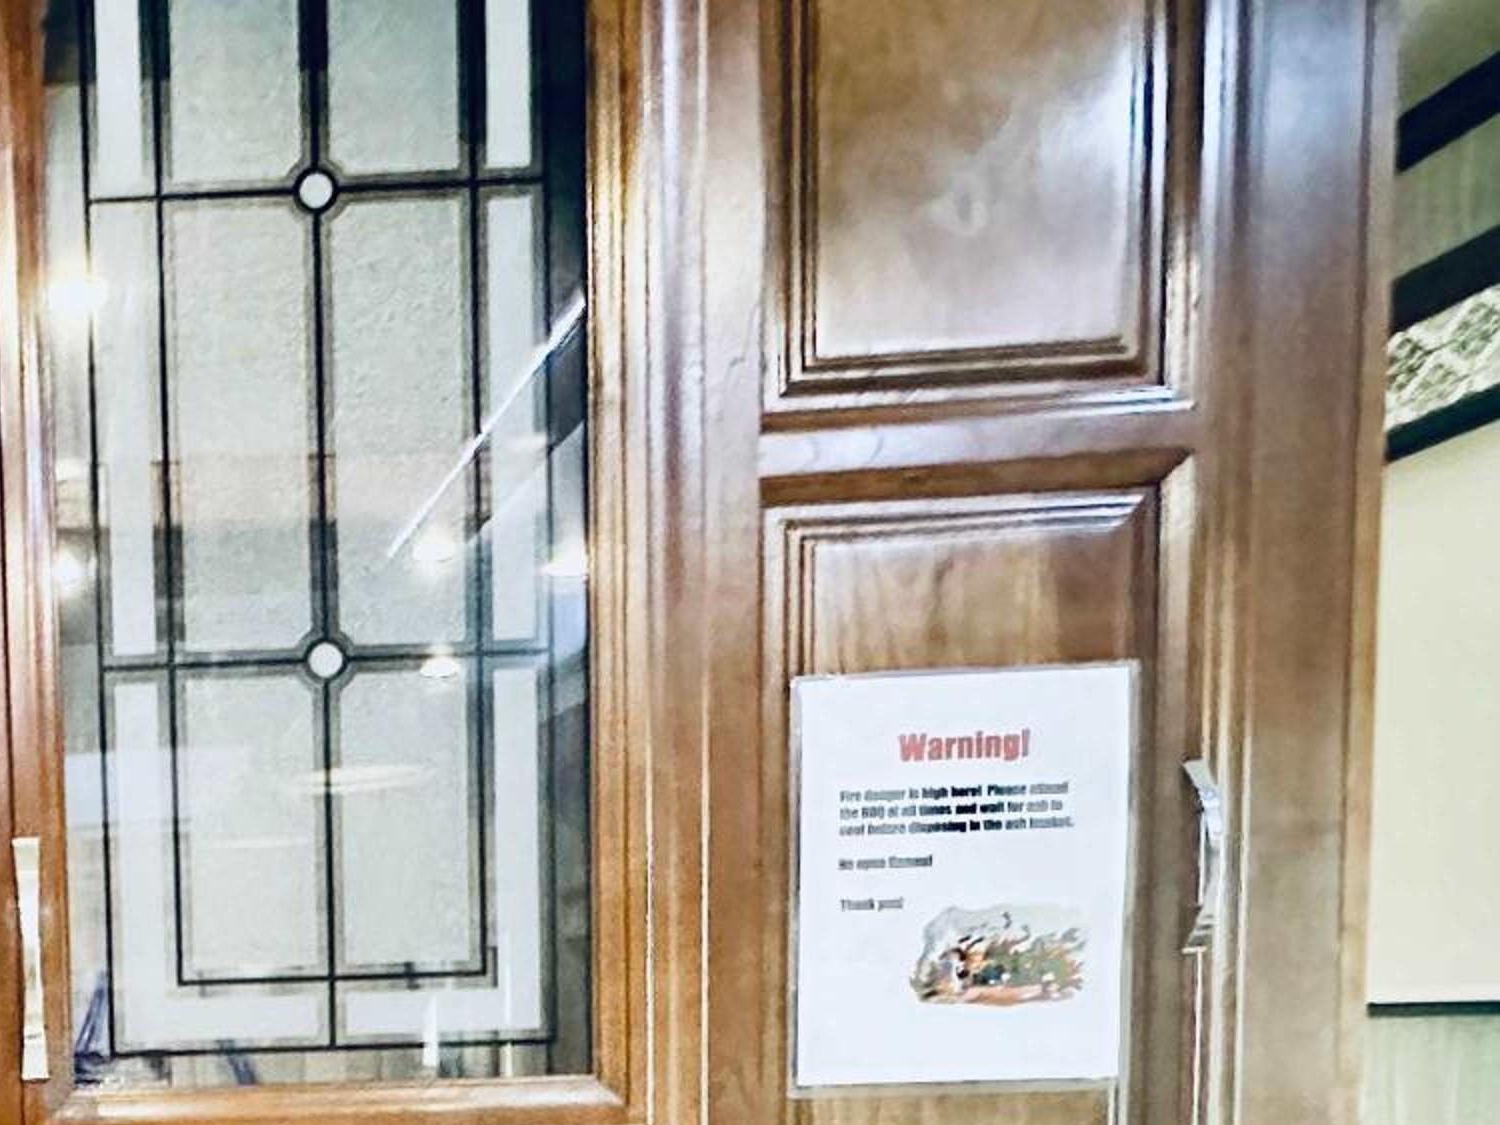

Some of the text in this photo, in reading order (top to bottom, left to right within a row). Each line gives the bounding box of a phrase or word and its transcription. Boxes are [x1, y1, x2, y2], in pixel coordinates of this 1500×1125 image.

[899, 729, 1030, 761] Warning!
[864, 789, 905, 803] dgr
[922, 787, 948, 801] high
[841, 897, 875, 911] Thk
